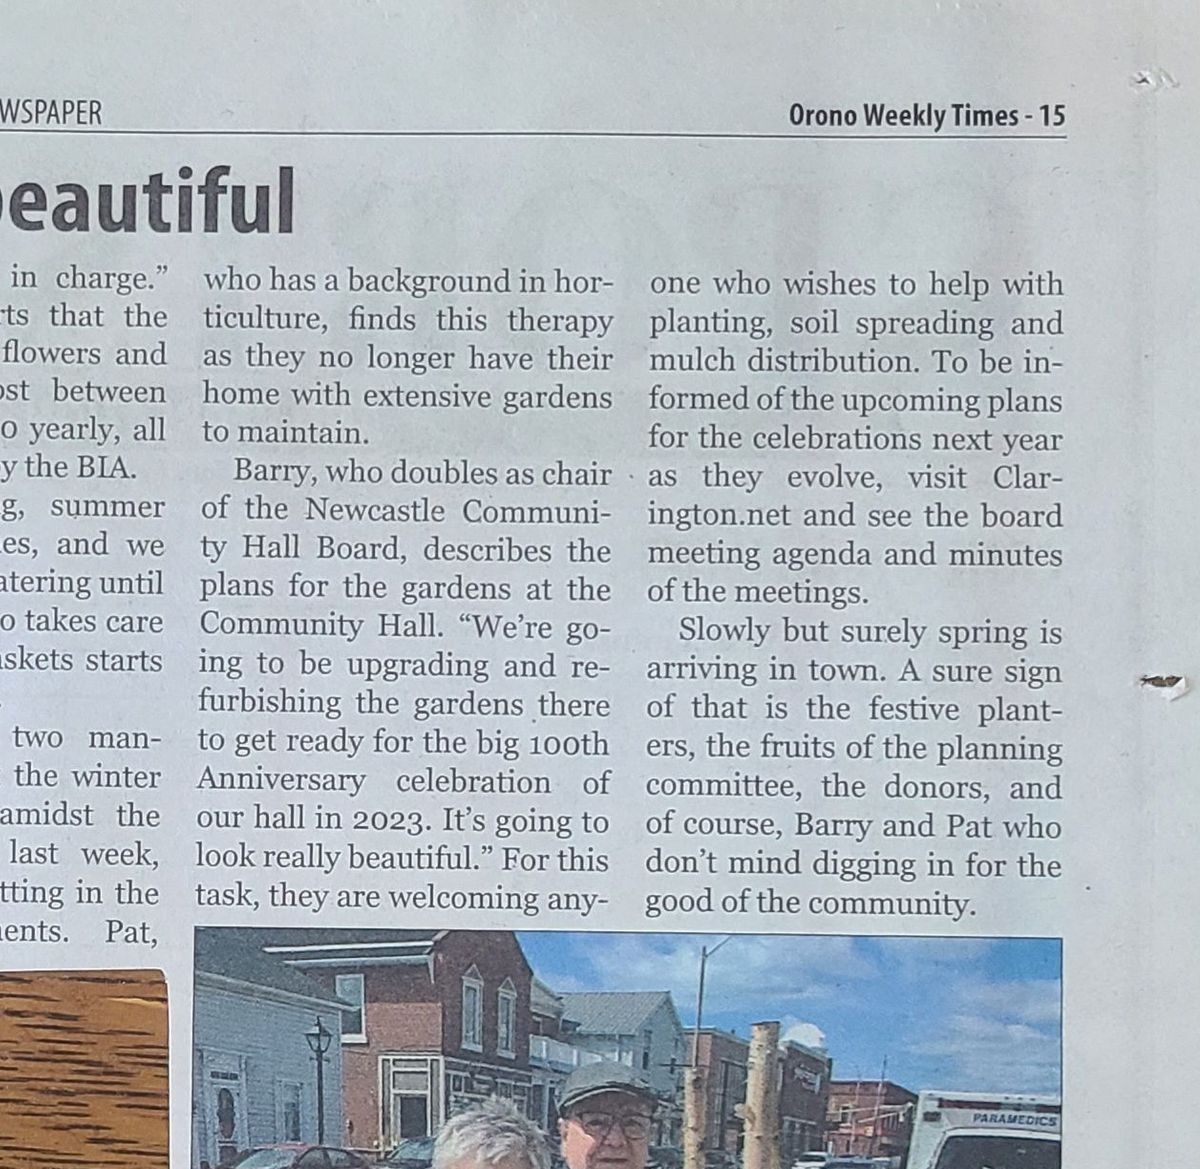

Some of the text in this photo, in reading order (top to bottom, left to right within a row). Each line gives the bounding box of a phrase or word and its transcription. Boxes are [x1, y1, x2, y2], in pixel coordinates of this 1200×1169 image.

[790, 103, 857, 126] Orono
[863, 103, 946, 133] Weekly
[951, 103, 1019, 126] Times
[1040, 104, 1065, 126] 15
[651, 269, 1064, 302] one who wishes to help with
[49, 301, 105, 327] that
[123, 303, 167, 328] the
[203, 304, 614, 338] ticulture, finds this therapy
[202, 379, 612, 414] home with extensive gardens
[29, 415, 120, 446] yearly,
[133, 416, 165, 441] all
[648, 500, 1064, 531] ington.net and see the board
[200, 533, 611, 565] ty Hall Board, describes the
[680, 616, 1062, 650] Slowly but surely spring is
[195, 765, 613, 797] Anniversary celebration of
[646, 772, 1063, 804] committee, the donors, and
[0, 800, 95, 826] amidst
[116, 802, 160, 827] the
[195, 881, 608, 917] task, they are welcoming any-
[105, 920, 157, 949] Pat,
[972, 1112, 1058, 1127] PARAMEDICS
